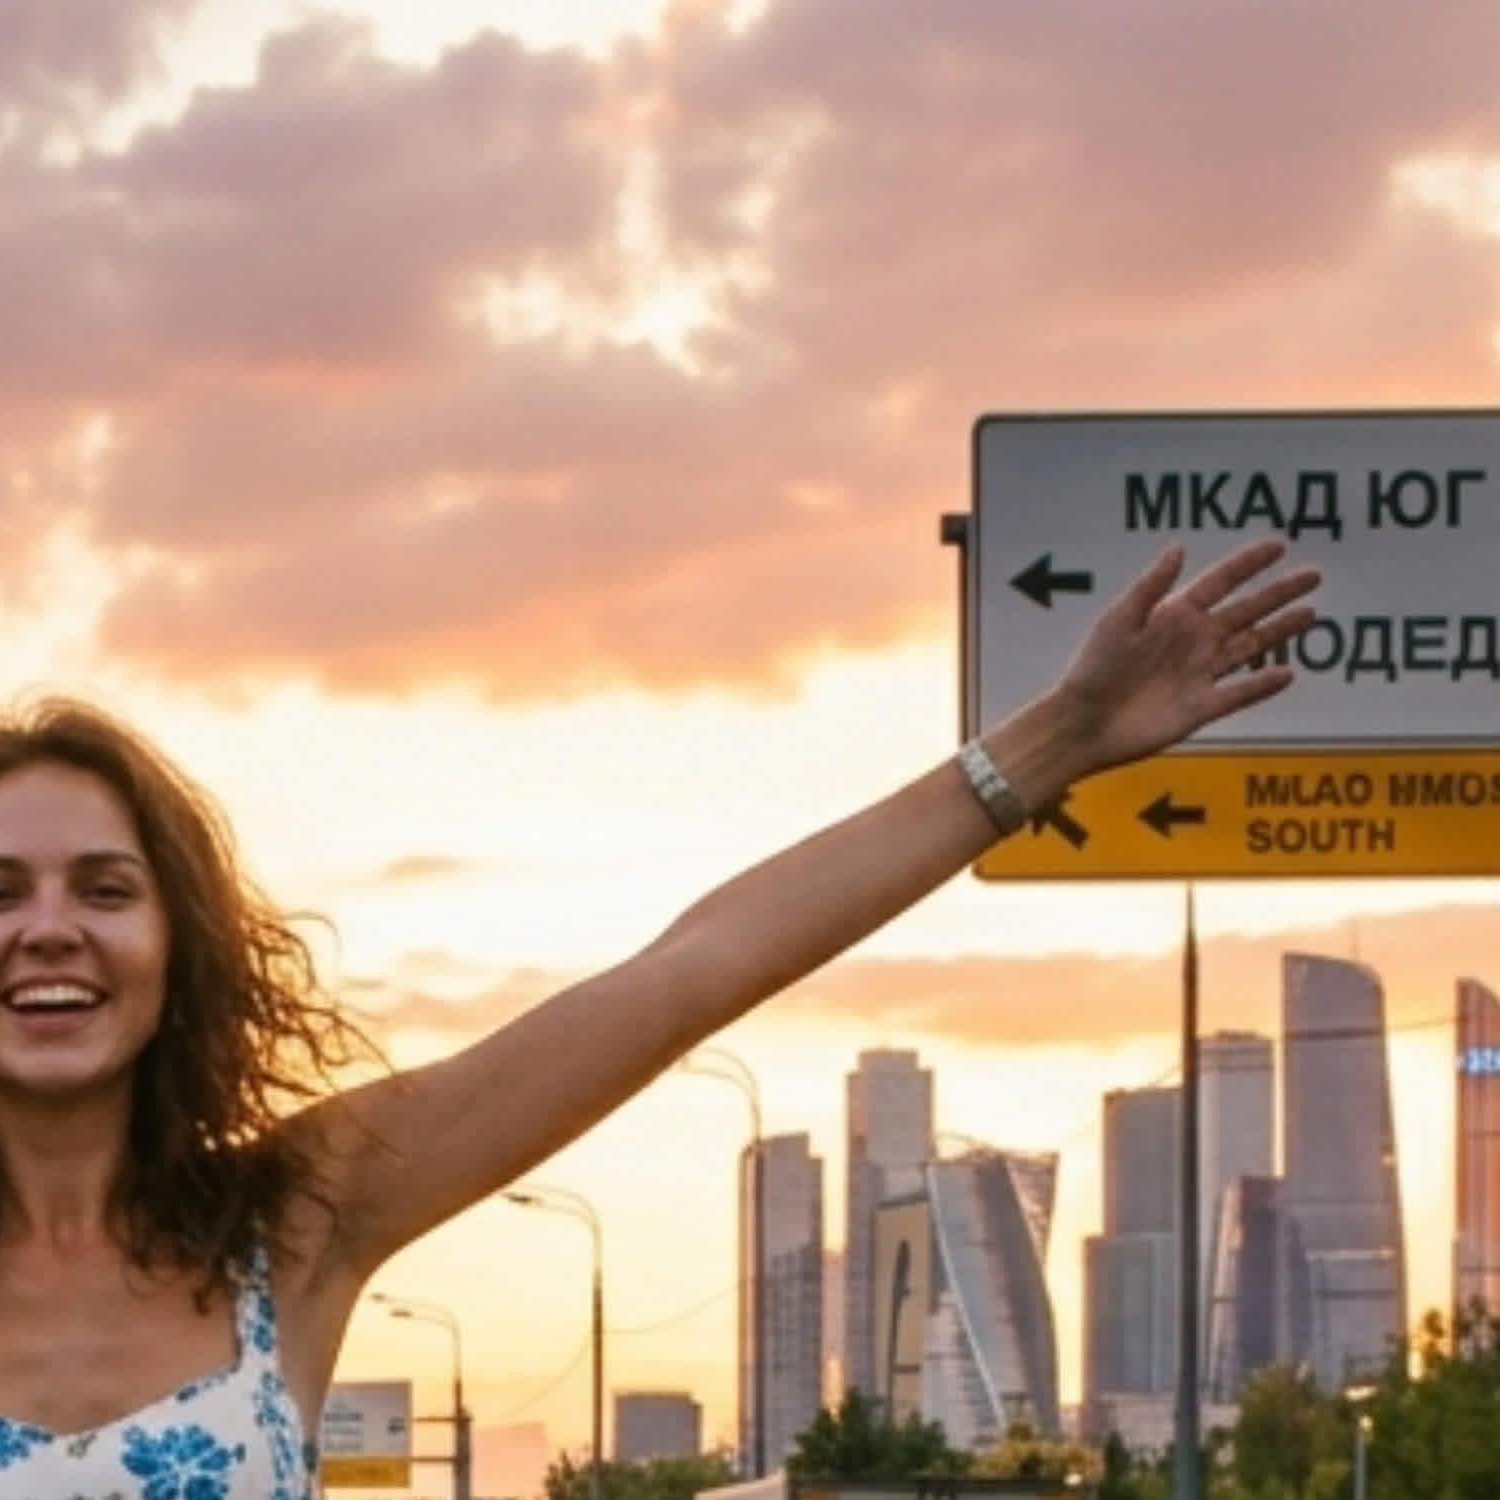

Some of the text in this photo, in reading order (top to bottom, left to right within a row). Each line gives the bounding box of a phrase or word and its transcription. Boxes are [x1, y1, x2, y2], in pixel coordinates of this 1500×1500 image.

[1124, 469, 1488, 541] МКАД ЮГ
[1250, 615, 1500, 683] ОДЕД
[1246, 818, 1397, 853] SOUTH
